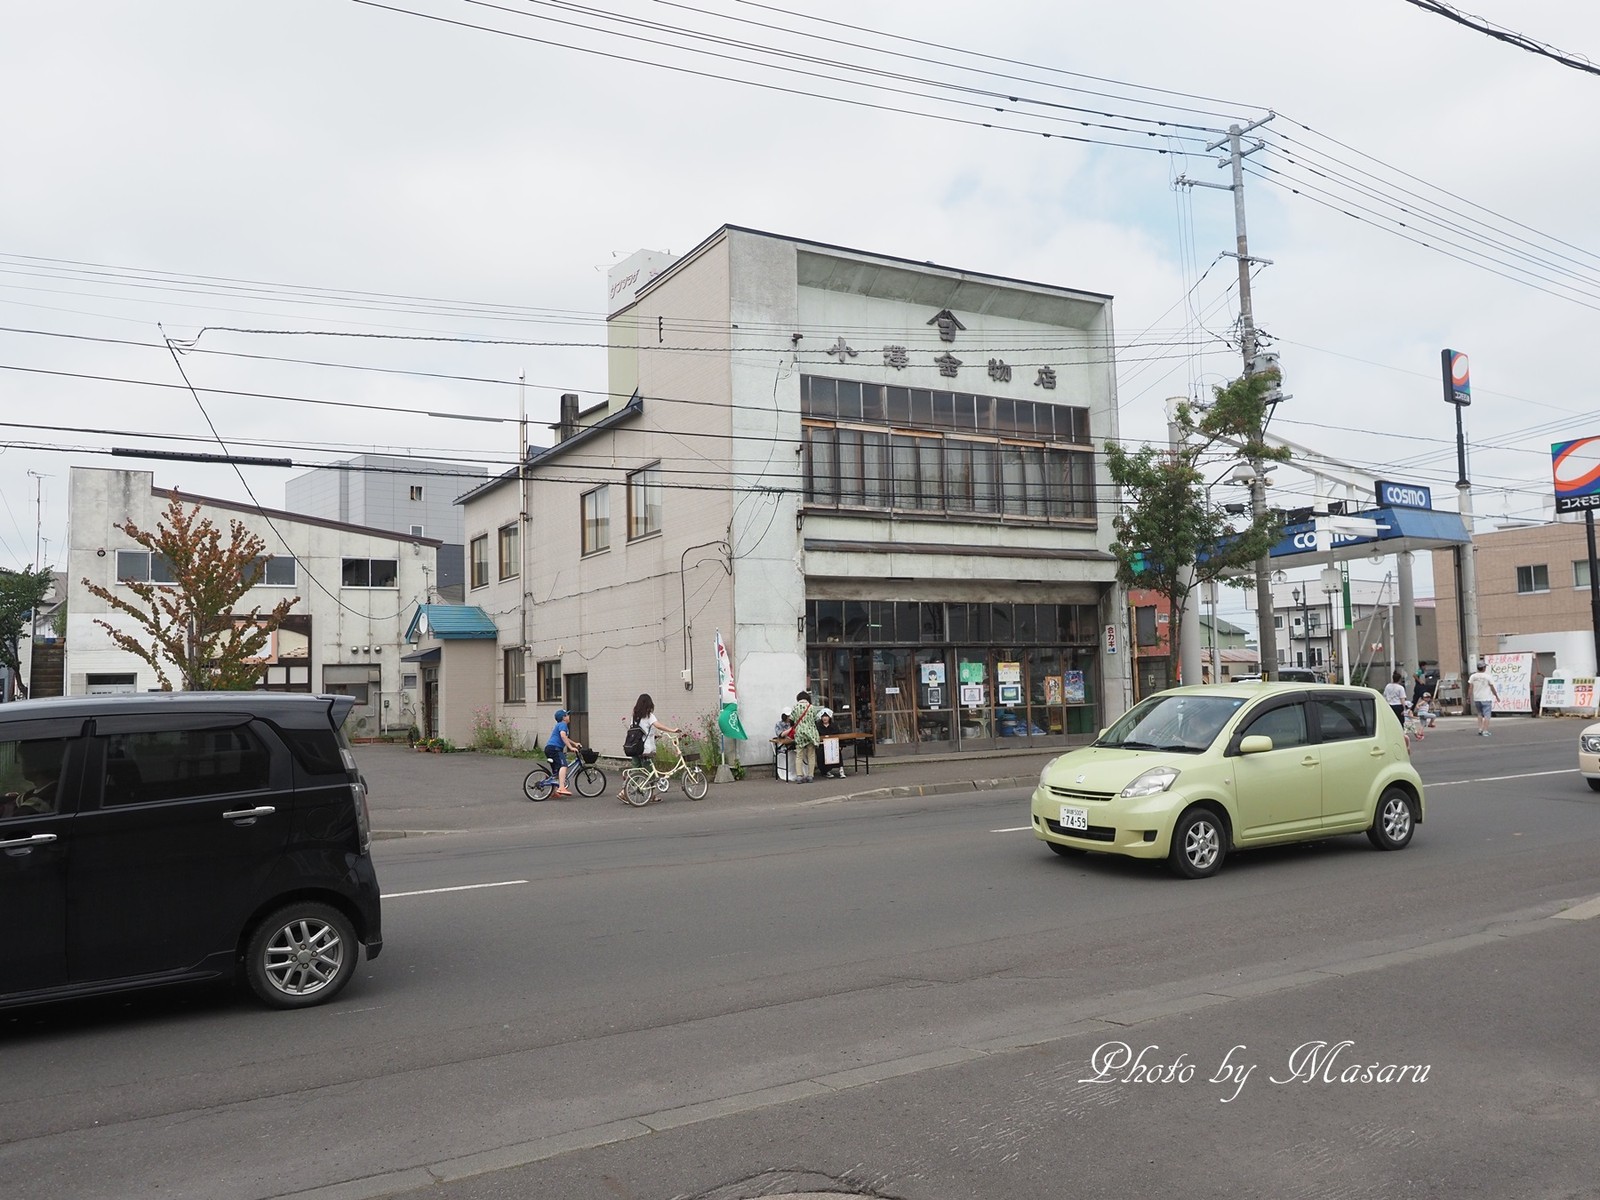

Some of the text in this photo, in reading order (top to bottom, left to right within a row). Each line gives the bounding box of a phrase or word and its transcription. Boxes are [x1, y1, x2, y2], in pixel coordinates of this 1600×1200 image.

[1387, 486, 1426, 507] COSMO
[1107, 626, 1115, 648] 合カギ
[1065, 815, 1086, 828] 74-59
